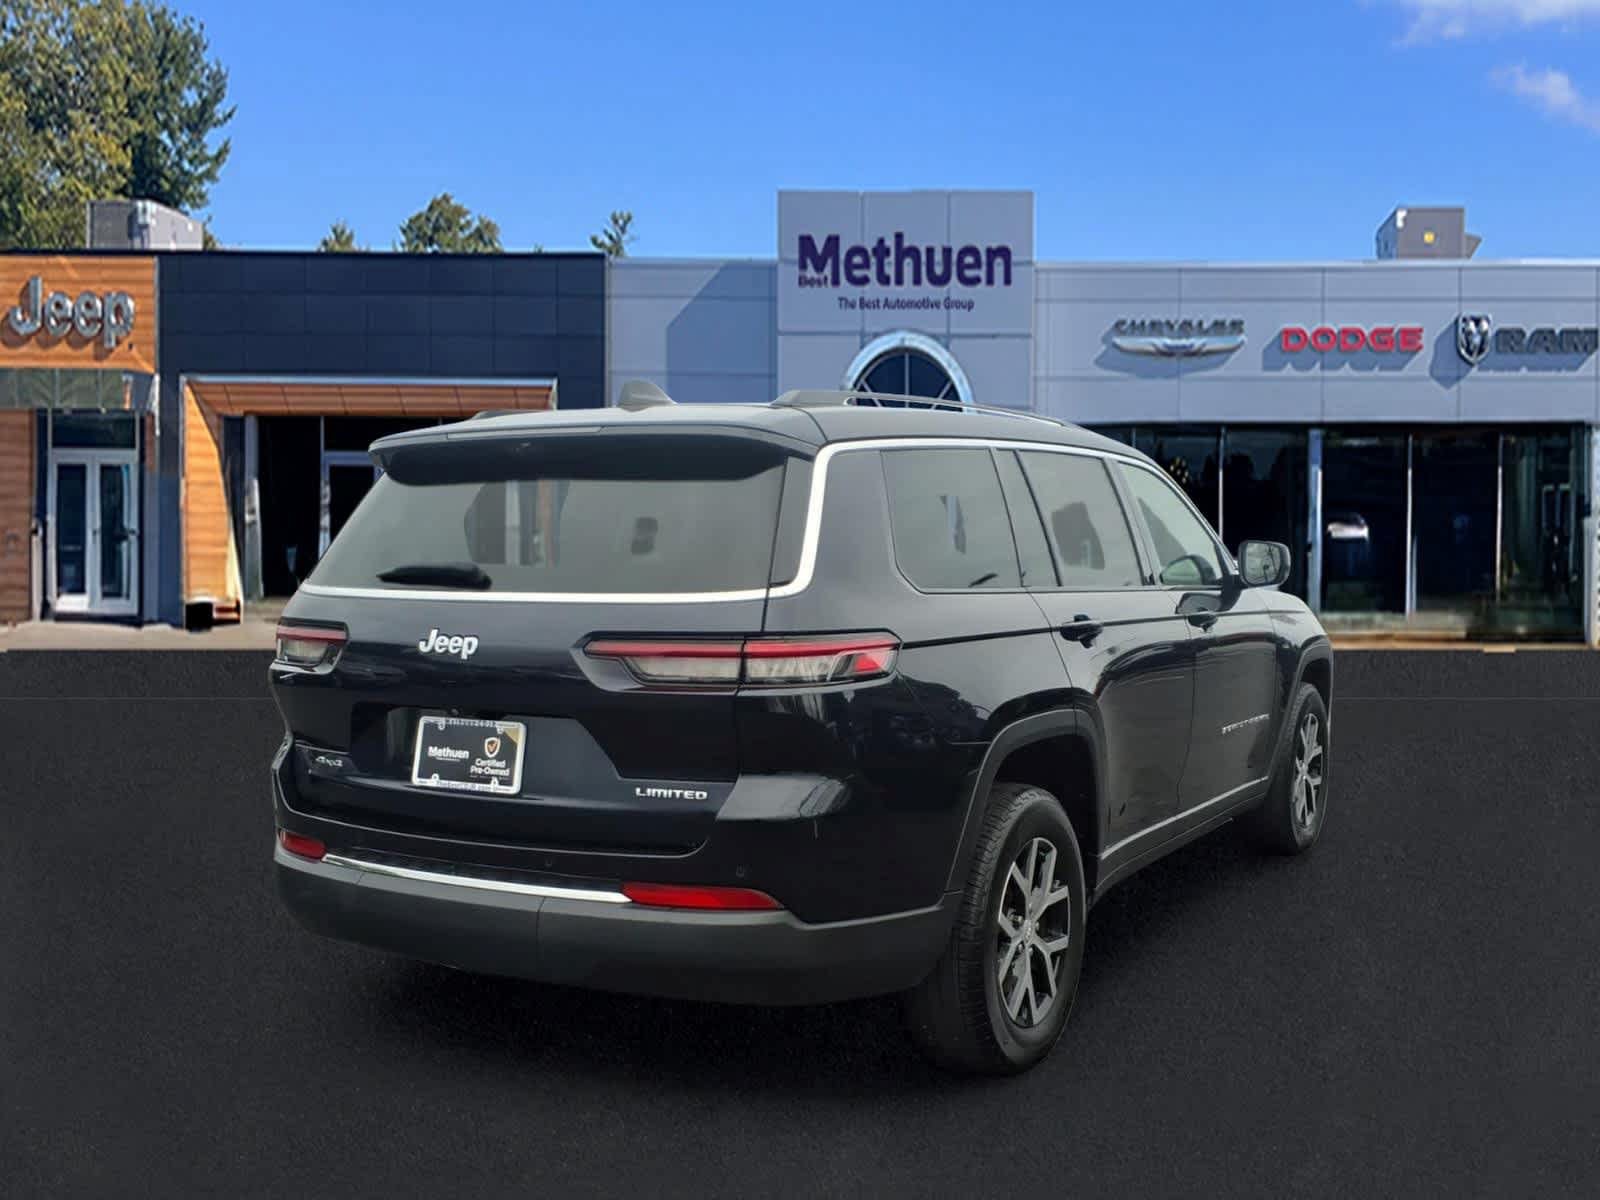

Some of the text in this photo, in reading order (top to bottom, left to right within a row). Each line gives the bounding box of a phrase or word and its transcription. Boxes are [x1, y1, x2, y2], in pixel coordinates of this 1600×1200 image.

[798, 232, 1012, 287] Methuen
[8, 275, 135, 348] Jeep
[838, 296, 975, 312] The Best Automotive Group
[1114, 319, 1244, 335] CHRYSLER
[1281, 327, 1424, 352] DODGE
[1495, 327, 1598, 353] RAM
[418, 628, 479, 660] Jeep
[427, 746, 470, 759] Methuen
[470, 765, 510, 776] Pre-Owned
[635, 787, 708, 800] LIMITED
